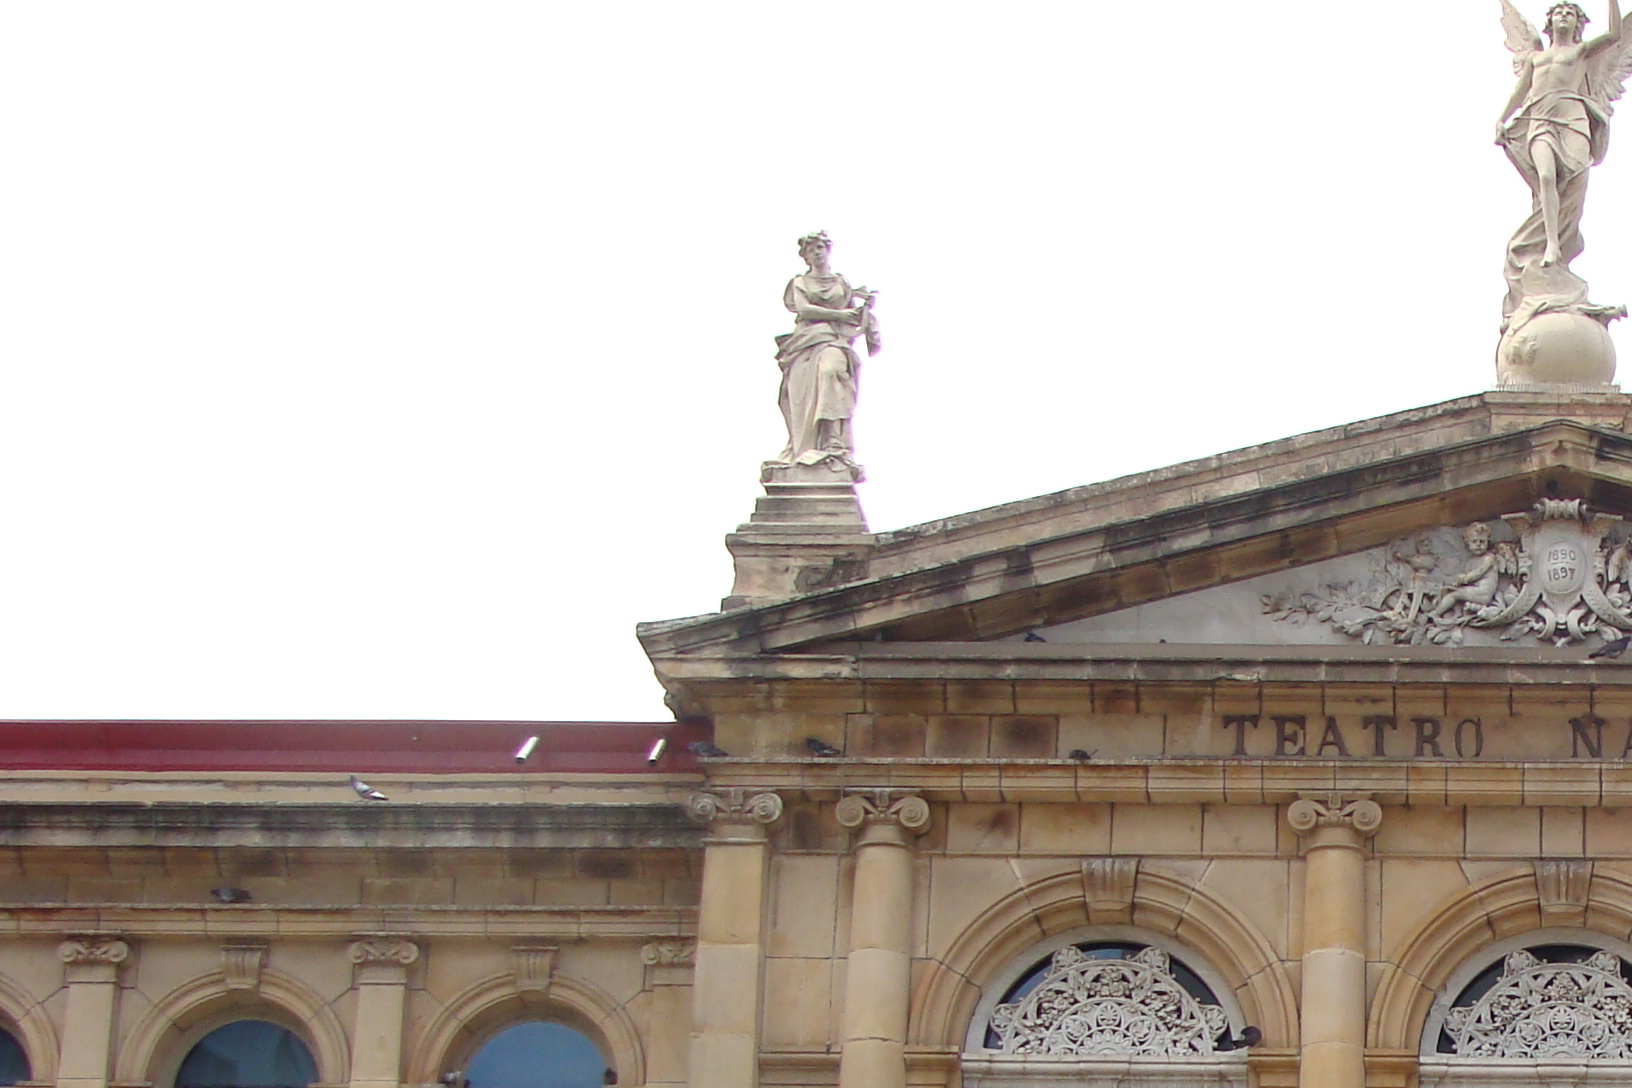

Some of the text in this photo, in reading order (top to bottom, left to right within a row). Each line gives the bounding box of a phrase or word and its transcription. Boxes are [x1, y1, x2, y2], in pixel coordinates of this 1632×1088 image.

[1547, 548, 1577, 562] 1890
[1547, 566, 1576, 583] 1897
[1222, 715, 1484, 758] TEATRO
